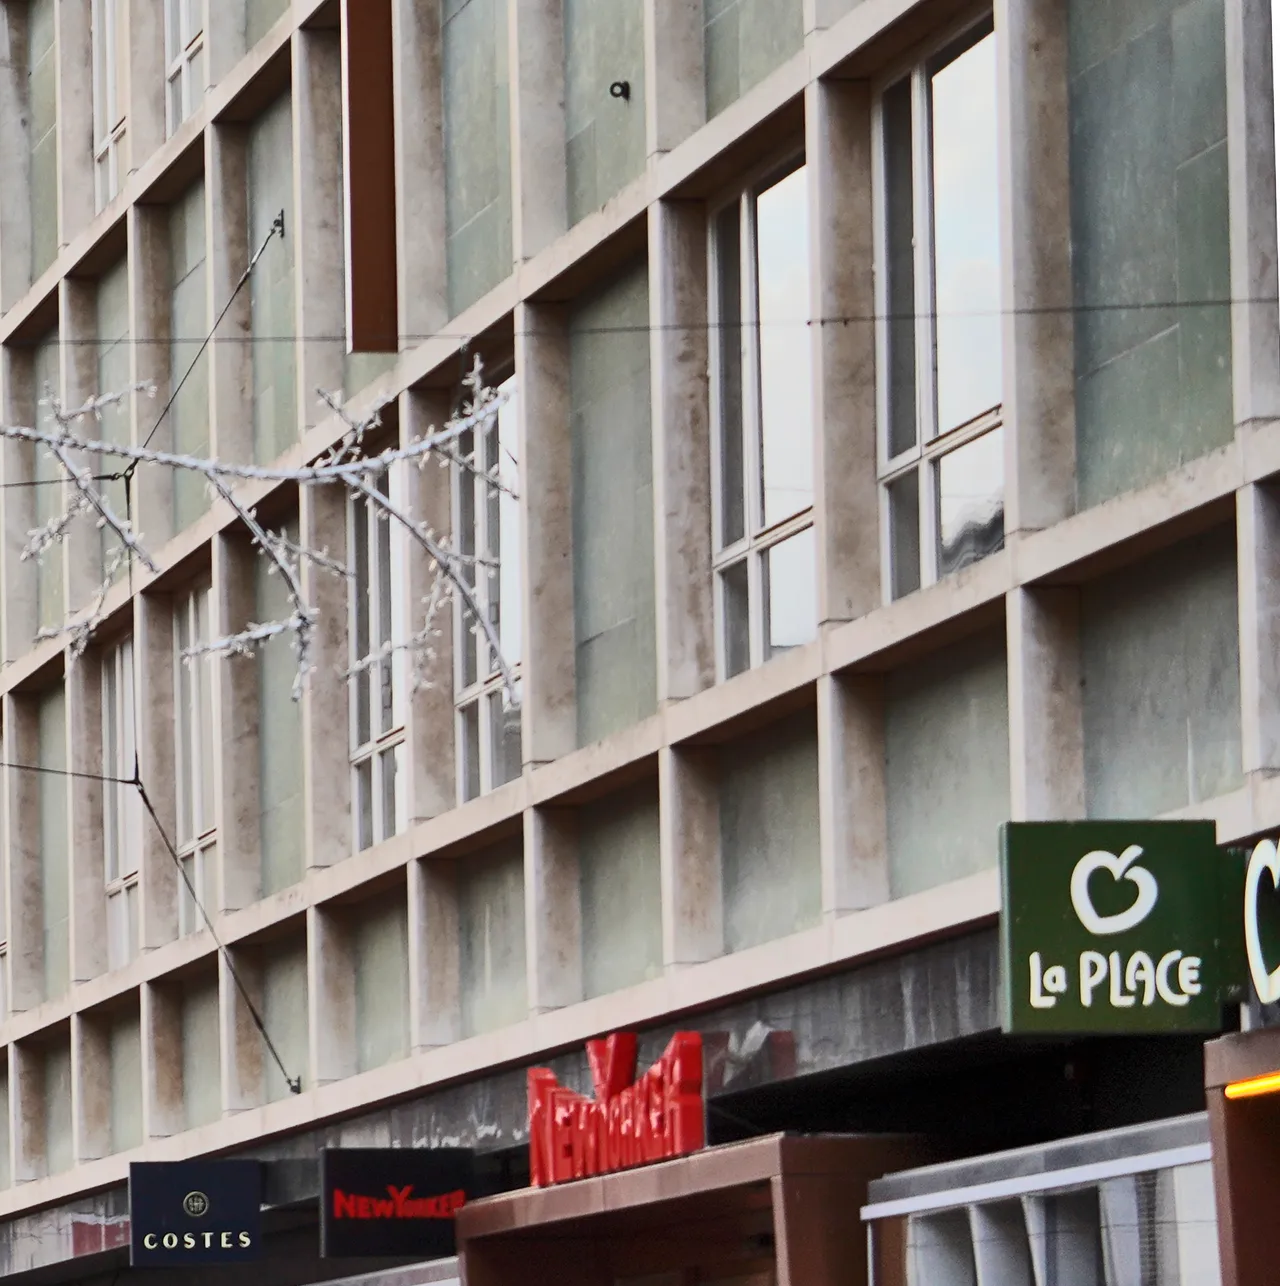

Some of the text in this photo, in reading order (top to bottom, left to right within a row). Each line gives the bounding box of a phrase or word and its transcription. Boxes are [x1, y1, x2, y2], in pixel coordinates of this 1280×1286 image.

[1029, 950, 1202, 1008] La PLACE
[143, 1231, 252, 1249] COSTES
